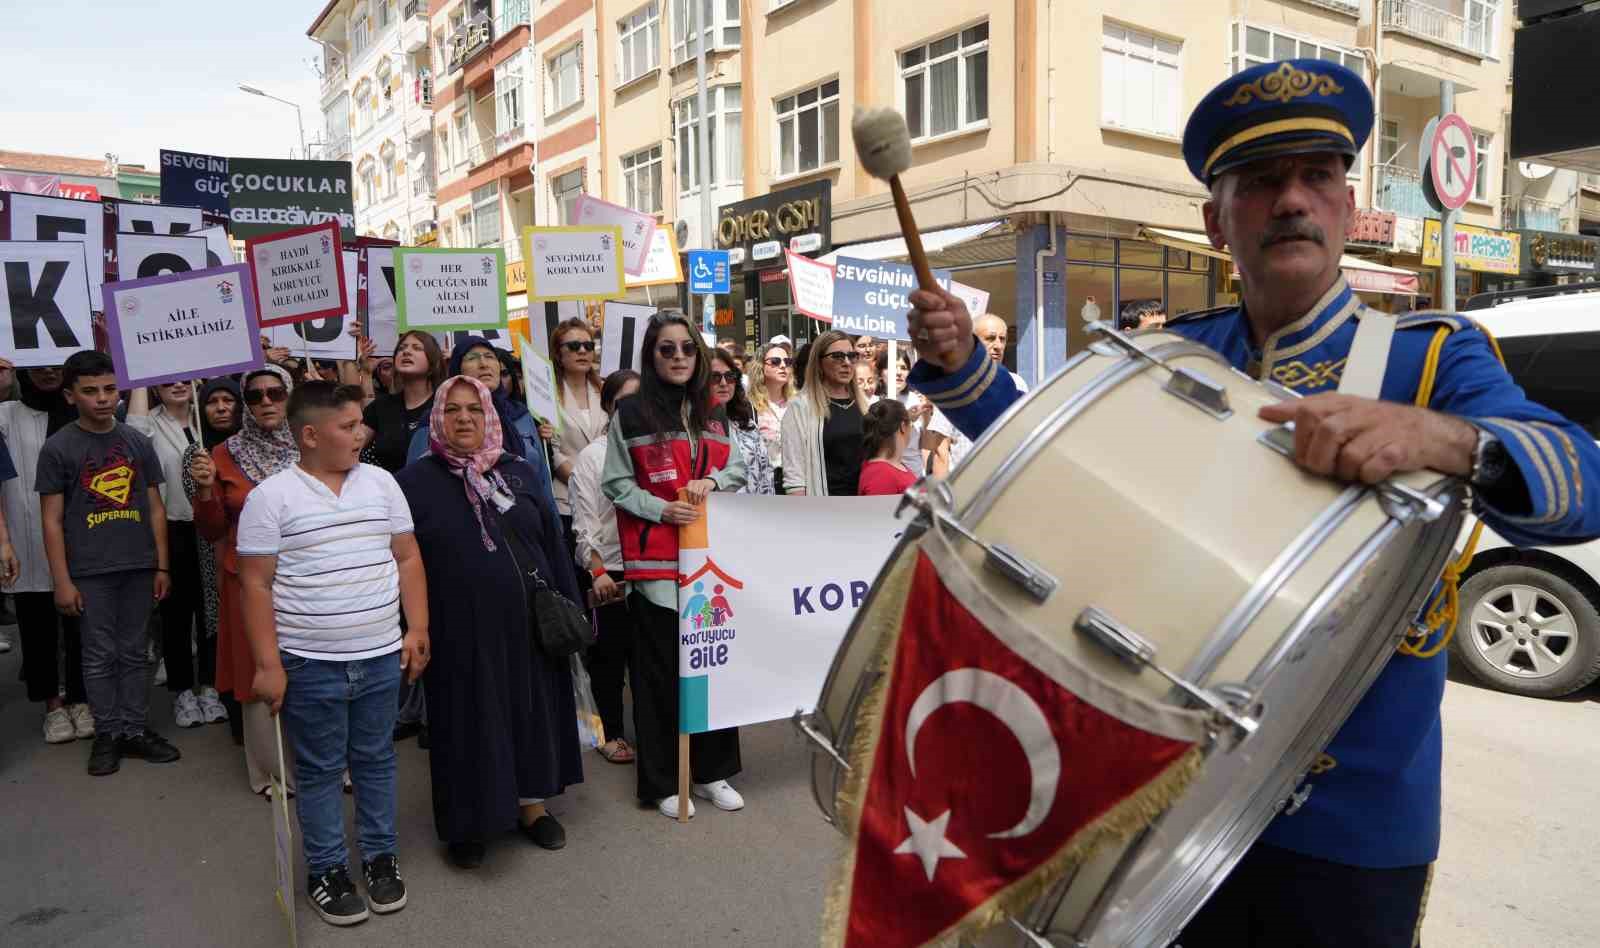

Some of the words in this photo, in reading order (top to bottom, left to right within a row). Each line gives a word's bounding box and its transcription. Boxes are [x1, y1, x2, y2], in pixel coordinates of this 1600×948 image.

[162, 153, 229, 174] SEVGİNİ
[194, 176, 229, 198] GÜÇ
[231, 173, 347, 194] ÇOCUKLAR
[719, 207, 770, 247] ÖMER
[776, 197, 821, 234] GSM
[280, 244, 309, 261] HAYDİ
[545, 252, 605, 263] SEVGİMİZLE
[271, 258, 321, 277] KIRIKKALE
[440, 264, 463, 273] HER
[546, 265, 605, 275] KORUYALIM
[836, 263, 914, 288] SEVGİNİN
[273, 275, 321, 292] KORUYUCU
[416, 276, 468, 288] ÇOCUĞUN
[470, 276, 488, 287] BİR
[4, 261, 81, 349] K
[272, 295, 292, 307] AİLE
[293, 289, 329, 303] OLALIM
[436, 291, 469, 301] AİLESİ
[864, 289, 915, 309] GÜÇL
[167, 307, 200, 323] AİLE
[432, 304, 474, 314] OLMALI
[136, 319, 234, 345] İSTİKBALİMİZ
[832, 314, 897, 334] HALİDİR
[793, 580, 869, 616] KOR
[690, 643, 728, 669] aile
